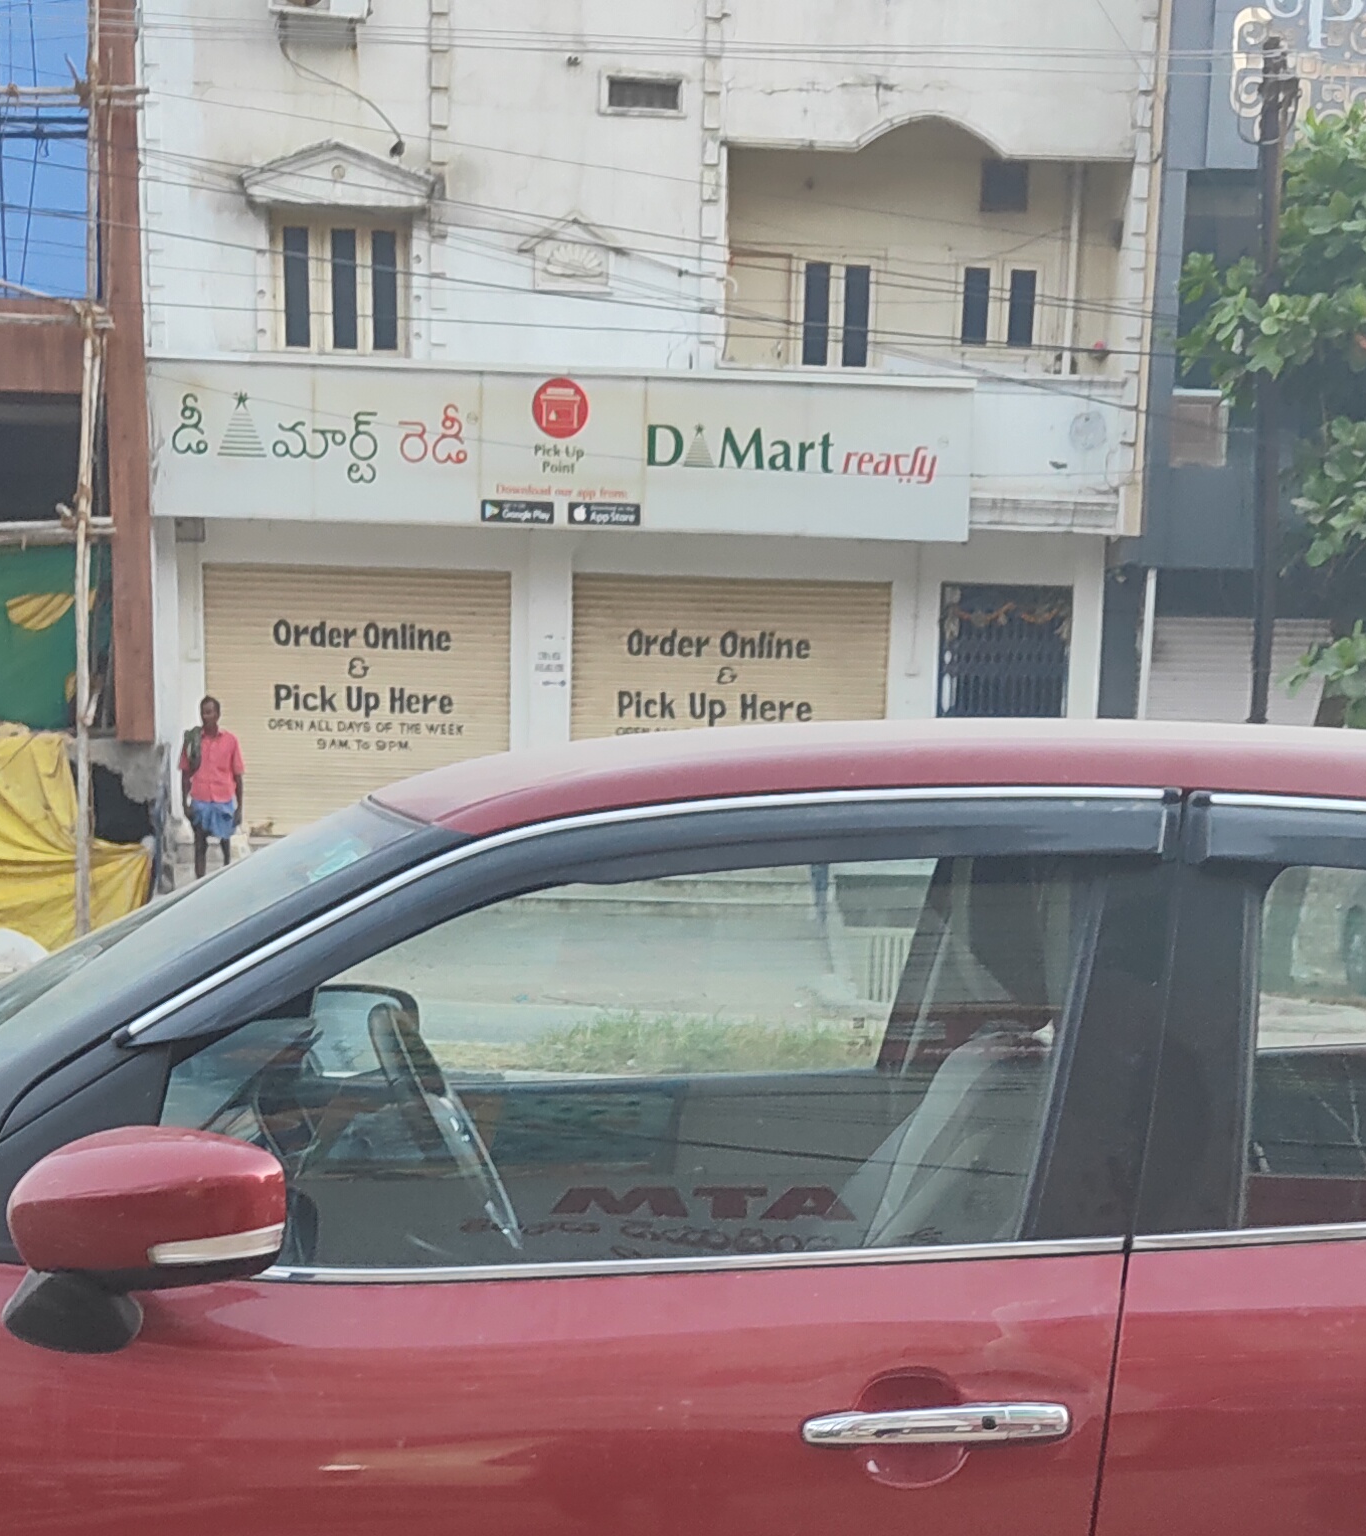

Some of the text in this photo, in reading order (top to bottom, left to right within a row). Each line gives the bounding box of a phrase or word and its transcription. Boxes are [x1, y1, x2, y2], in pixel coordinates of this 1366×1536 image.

[398, 404, 468, 464] రెడీ
[535, 444, 584, 461] Pick Up
[542, 461, 575, 474] Point
[496, 484, 551, 496] Download
[579, 487, 596, 500] app
[273, 619, 452, 652] Order Online
[627, 629, 811, 660] Order Online
[348, 657, 370, 679] &
[716, 666, 738, 684] &
[273, 684, 454, 717] Pick Up Here
[617, 690, 813, 727] Pick Up Here
[268, 718, 464, 736] OPEN ALL DAYS OF THE WEEK
